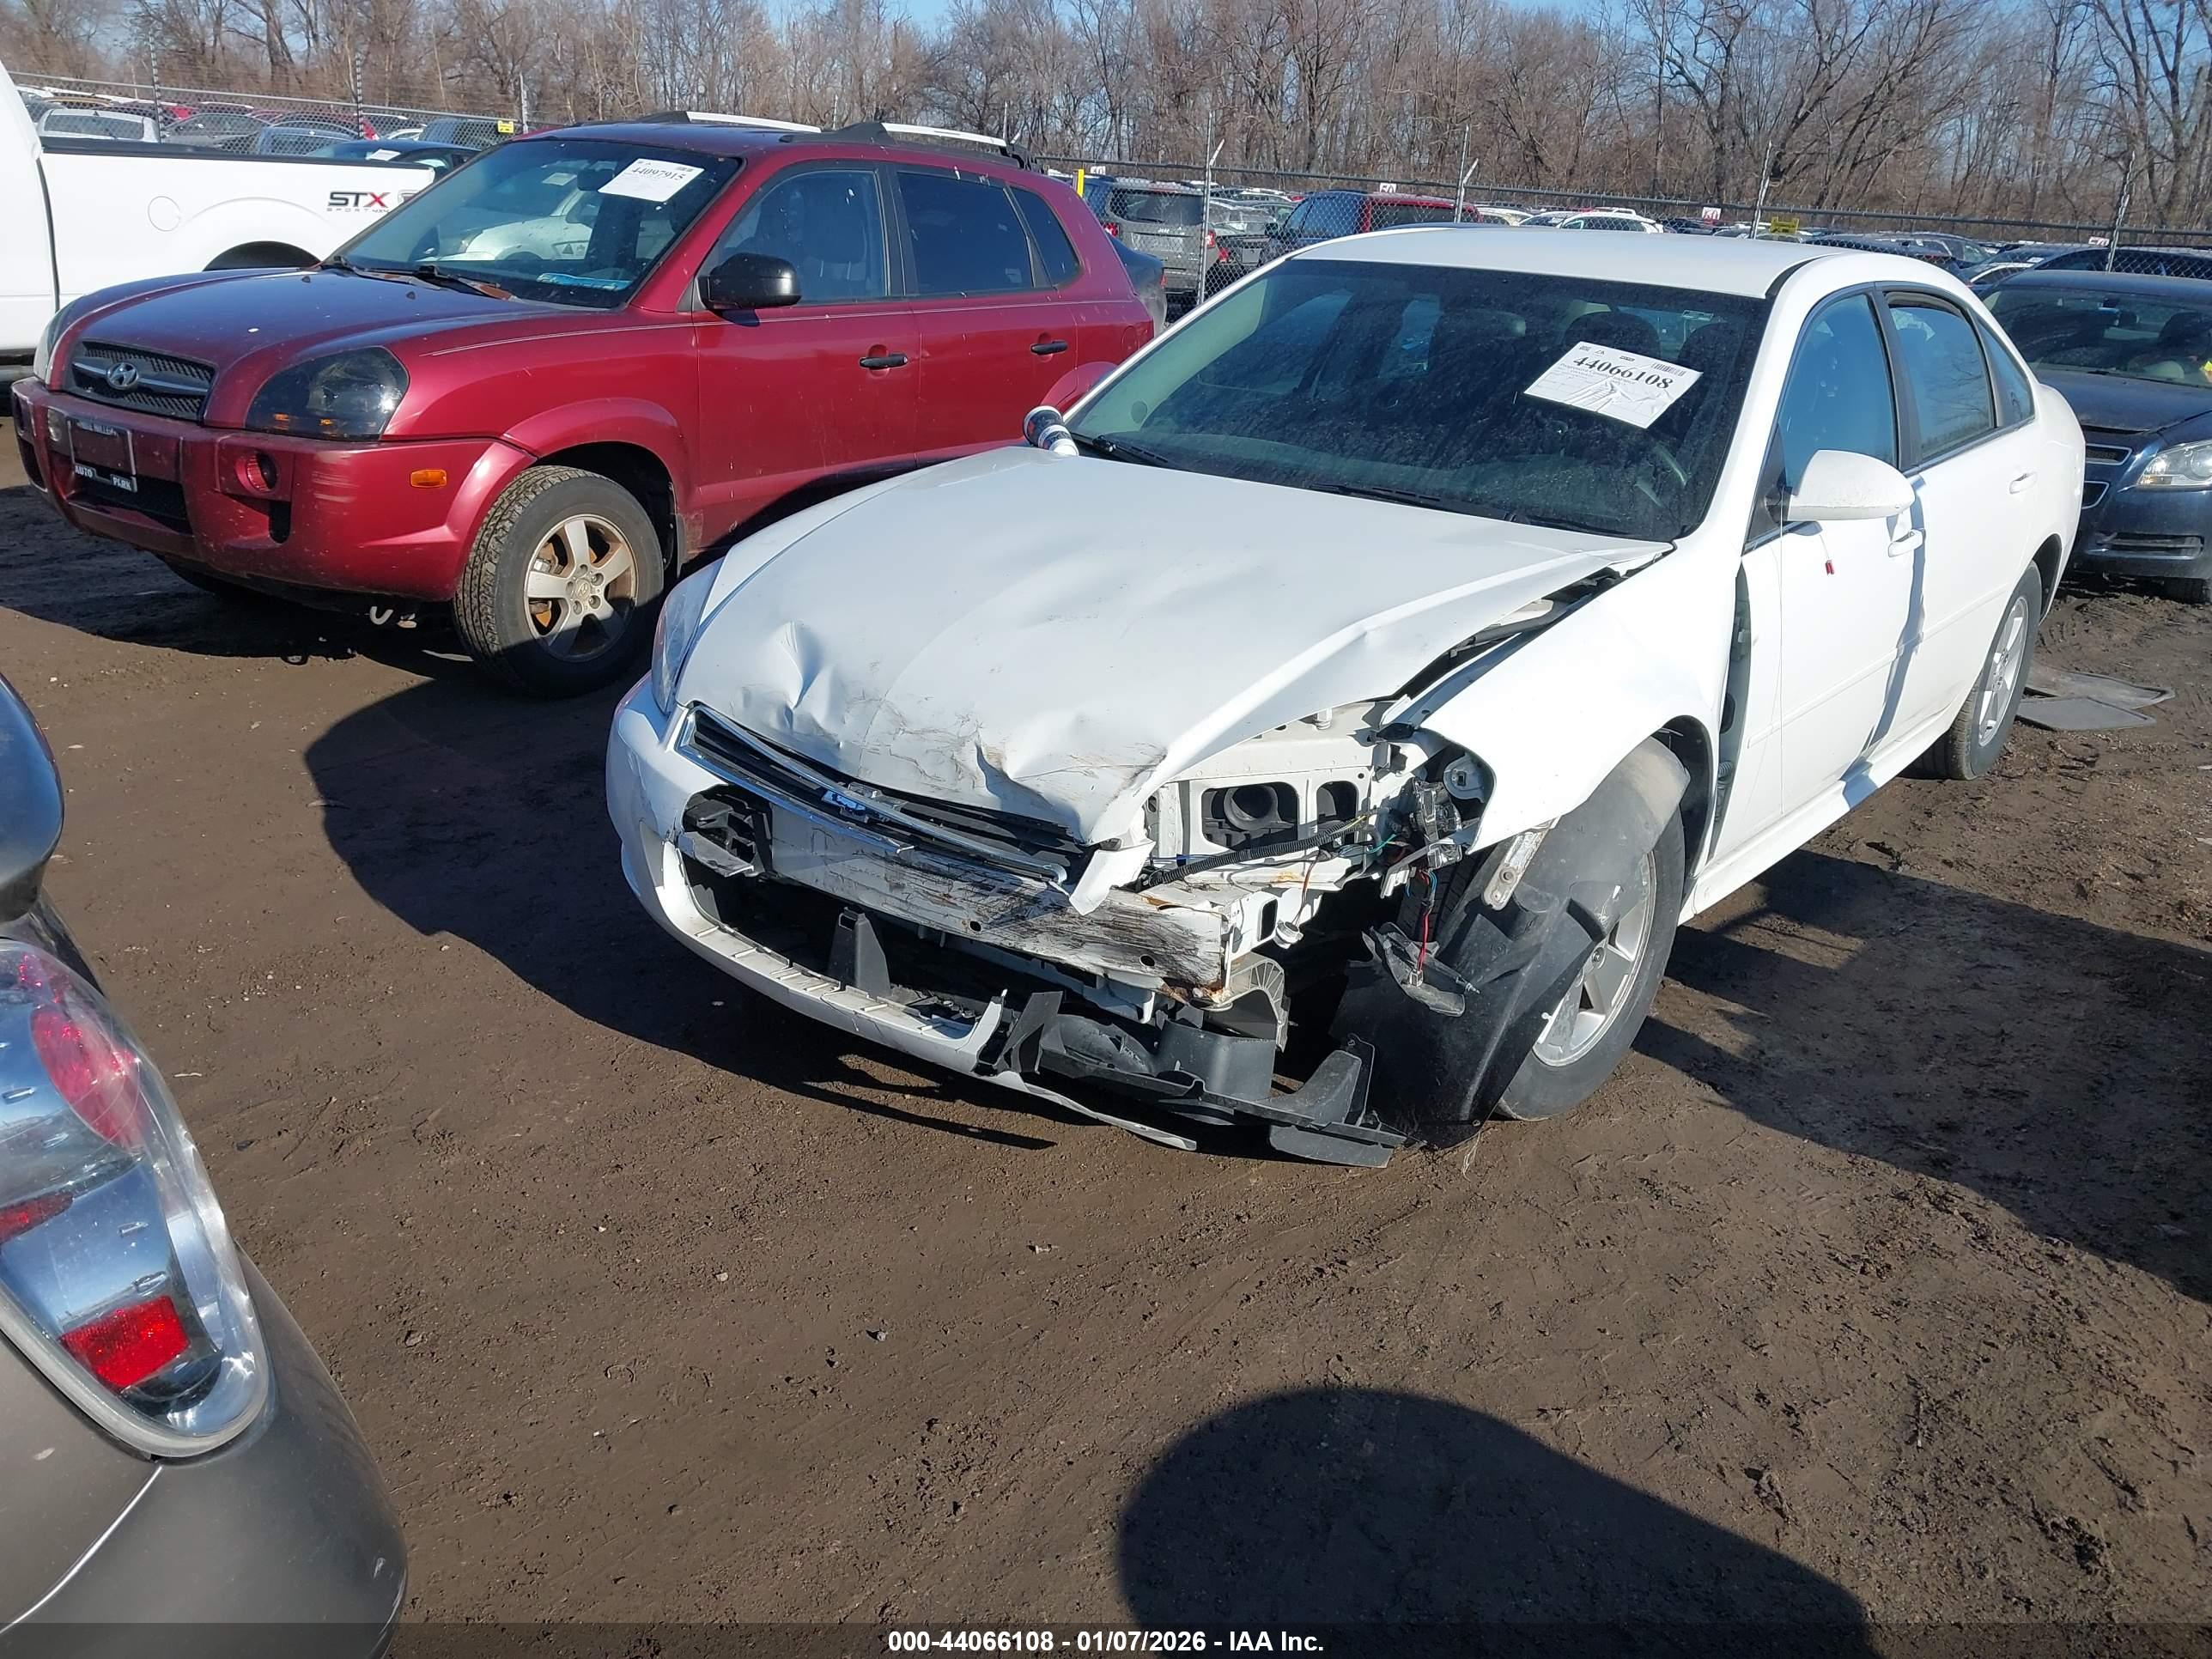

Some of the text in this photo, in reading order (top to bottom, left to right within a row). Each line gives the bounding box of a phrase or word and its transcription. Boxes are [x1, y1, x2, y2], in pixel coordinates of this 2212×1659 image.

[328, 191, 391, 208] STX
[1573, 356, 1674, 389] 44066108
[75, 465, 94, 478] AUTO
[112, 477, 132, 491] PARK
